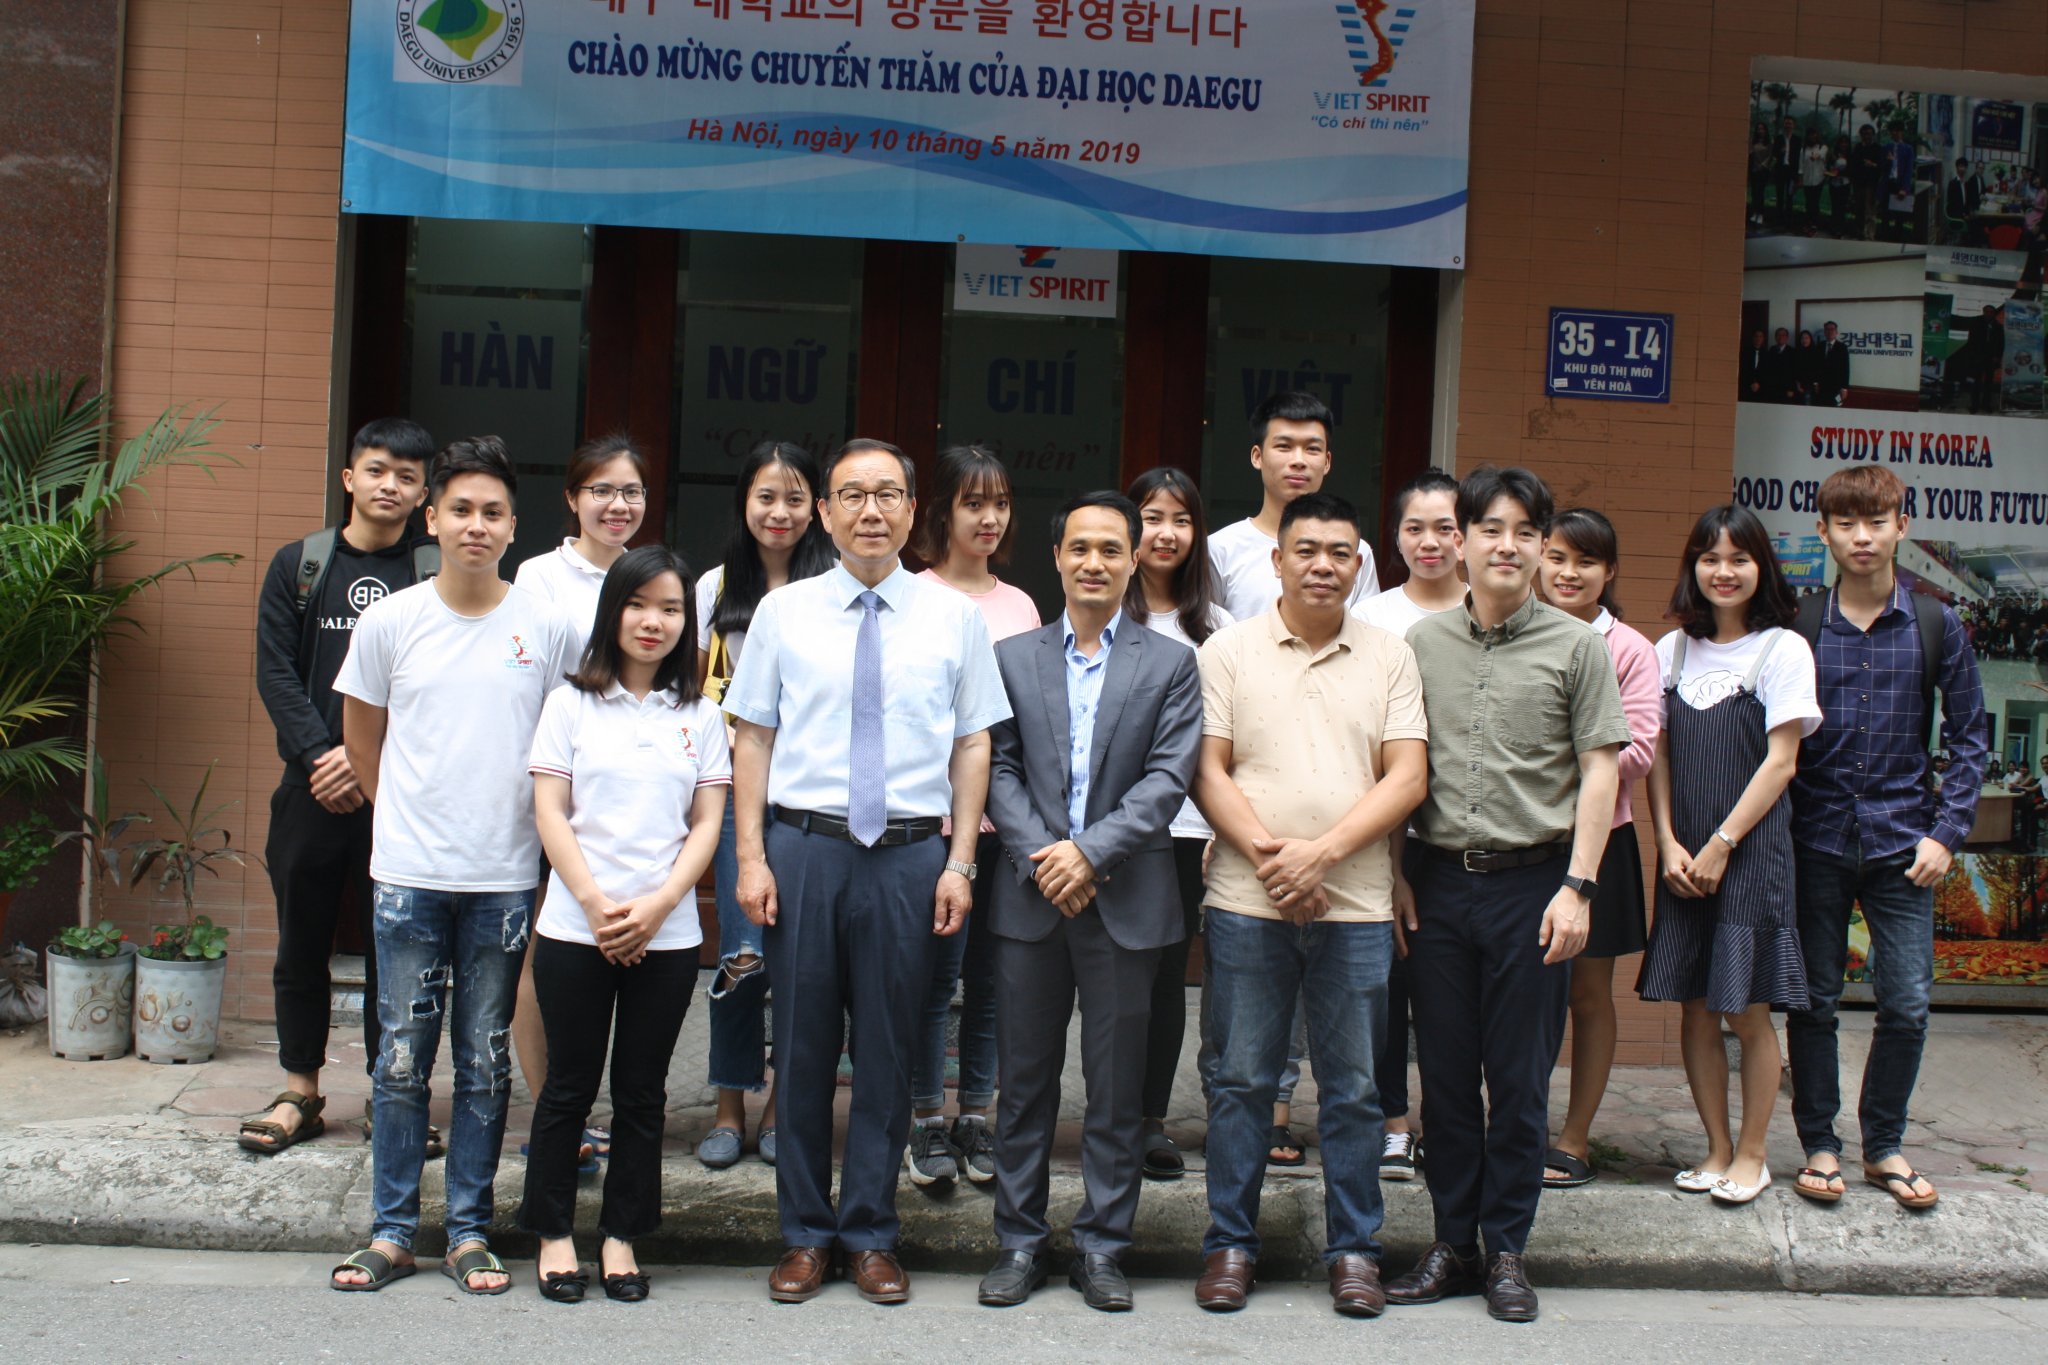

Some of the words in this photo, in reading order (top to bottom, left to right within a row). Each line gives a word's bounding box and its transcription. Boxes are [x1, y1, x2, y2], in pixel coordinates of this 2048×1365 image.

[1032, 0, 1249, 48] 환영합니다
[399, 11, 423, 61] DAEGU
[423, 50, 508, 80] UNIVERSITY
[505, 16, 522, 50] 1956
[568, 34, 648, 76] CHÀO
[656, 37, 742, 81] MỪNG
[751, 41, 870, 89] CHUYẾN
[879, 50, 960, 93] THĂM
[969, 51, 1028, 98] CỦA
[1037, 67, 1088, 109] ĐẠI
[1097, 70, 1156, 113] HỌC
[1162, 73, 1262, 111] DAEGU
[1315, 91, 1362, 110] VIET
[1368, 93, 1431, 113] SPIRIT
[688, 118, 723, 141] Hà
[732, 121, 784, 149] Nội,
[793, 128, 859, 154] ngày
[868, 129, 898, 151] 10
[906, 129, 983, 160] tháng
[990, 136, 1006, 157] 5
[1013, 137, 1070, 160] năm
[1080, 140, 1140, 164] 2019
[963, 273, 1023, 297] VIET
[1028, 277, 1111, 303] SPIRIT
[1558, 320, 1595, 357] 35
[1624, 326, 1661, 361] I4
[1841, 333, 1913, 349] 강남대학교
[440, 321, 554, 390] HÀN
[707, 338, 827, 404] NGỮ
[986, 349, 1077, 416] CHÍ
[1564, 363, 1588, 374] KHU
[1590, 363, 1607, 375] ĐÔ
[1610, 365, 1628, 379] THỊ
[1631, 365, 1653, 378] MỚI
[1583, 378, 1606, 390] YÊN
[1811, 426, 1884, 461] STUDY
[1890, 430, 1914, 462] IN
[1919, 432, 1994, 468] KOREA
[1924, 487, 1984, 522] YOUR
[1989, 491, 2048, 525] FUTU
[1780, 563, 1813, 576] SPIRIT
